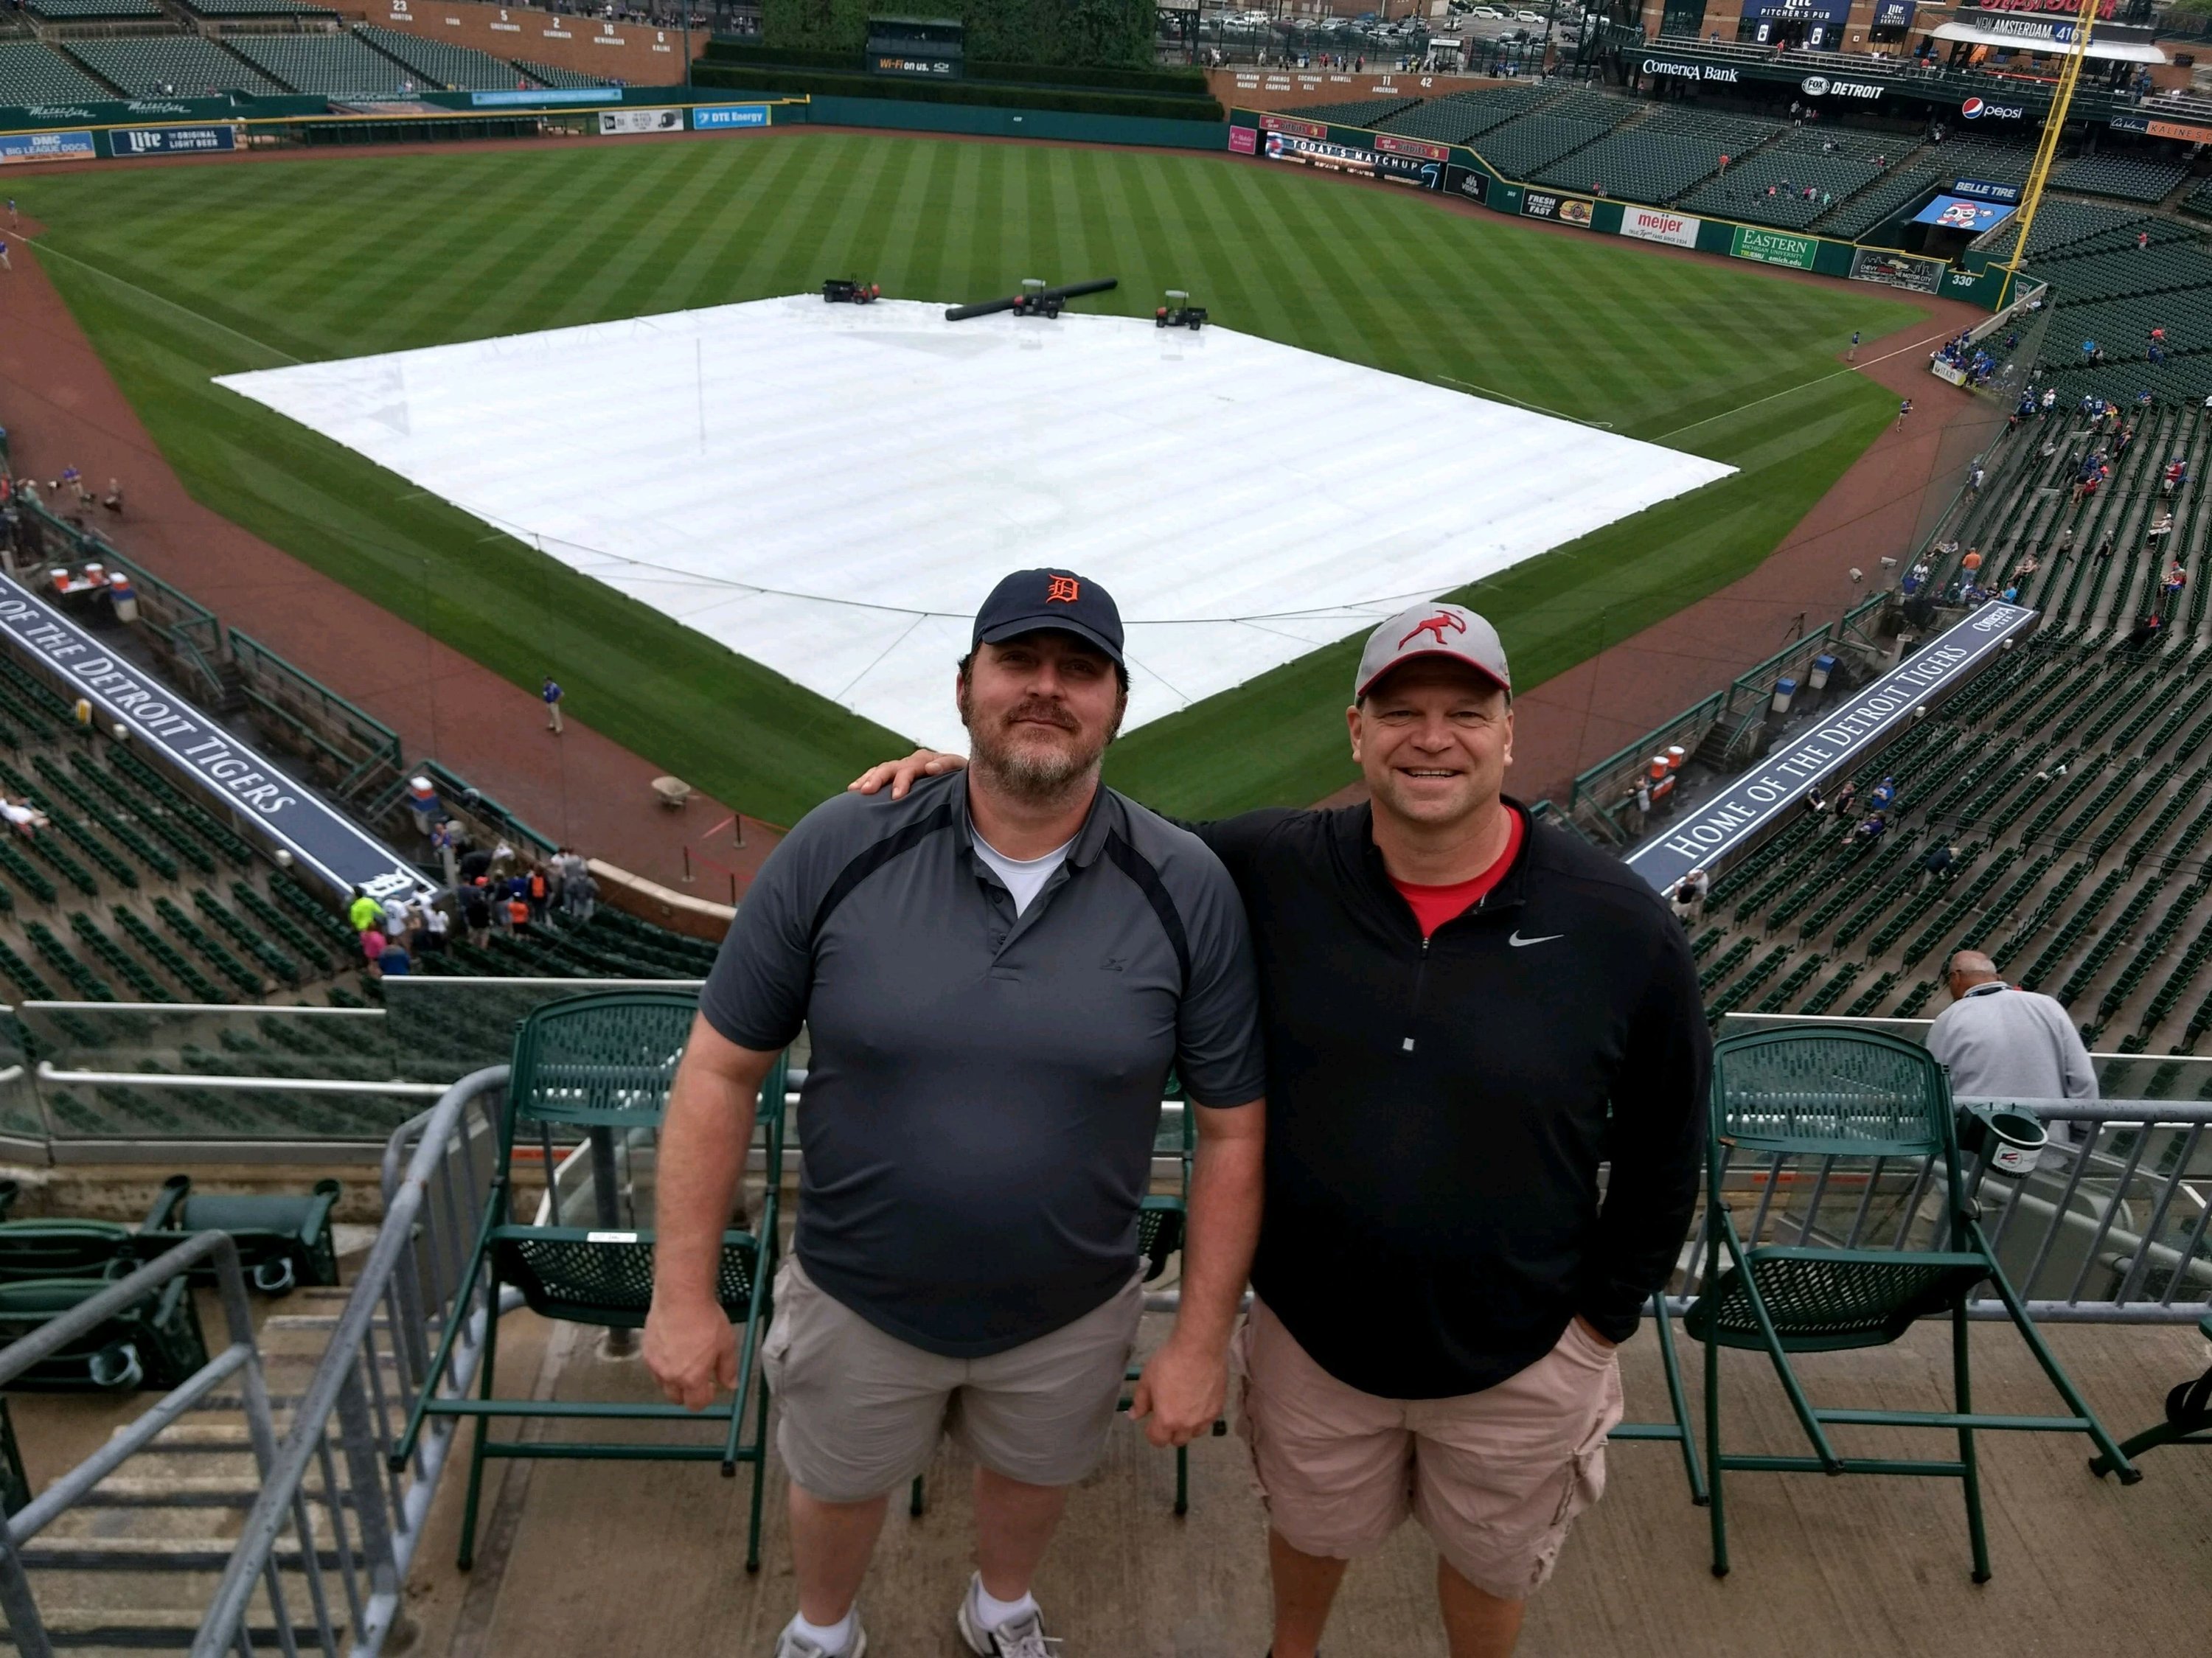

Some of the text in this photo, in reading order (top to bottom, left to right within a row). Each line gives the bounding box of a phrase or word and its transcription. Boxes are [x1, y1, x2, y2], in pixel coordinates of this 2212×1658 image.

[393, 0, 407, 11] 23
[1888, 4, 1904, 15] Lite
[500, 10, 508, 21] 5
[1760, 8, 1830, 19] PITCHER'S PUB
[553, 17, 560, 29] 2
[1975, 16, 1994, 31] NEW
[1992, 19, 2053, 39] AMSTERDAM
[603, 24, 614, 35] 16
[657, 31, 664, 43] 6
[880, 59, 903, 69] Wi-Fi
[904, 62, 915, 71] on
[916, 63, 929, 72] us.
[1703, 66, 1739, 83] Bank
[1382, 75, 1391, 86] 11
[1420, 77, 1433, 88] 42
[1807, 80, 1823, 88] FOX
[1831, 82, 1885, 99] DETROIT
[712, 111, 762, 122] DTE Energy
[1983, 106, 2023, 119] pepsi
[177, 130, 217, 139] ORIGINAL
[32, 136, 61, 145] DMC
[128, 131, 161, 153] Lite
[6, 147, 22, 156] BIG
[1293, 140, 1346, 157] TODAY'S
[1355, 152, 1418, 170] MATCHUP
[1955, 181, 2016, 198] BELLE TIRE
[1528, 195, 1556, 206] FRESH
[1528, 206, 1551, 216] FAST
[1638, 213, 1683, 233] meijer
[1742, 230, 1808, 254] EASTERN
[1742, 244, 1804, 260] MICHIGAN UNIVERSITY
[1768, 256, 1802, 266] emich.edu
[1952, 275, 1975, 286] 330'
[1046, 574, 1079, 603] D
[0, 600, 296, 814] OF THE DETROIT TIGERS
[1664, 644, 1968, 860] HOME OF THE DETROIT TIGERS
